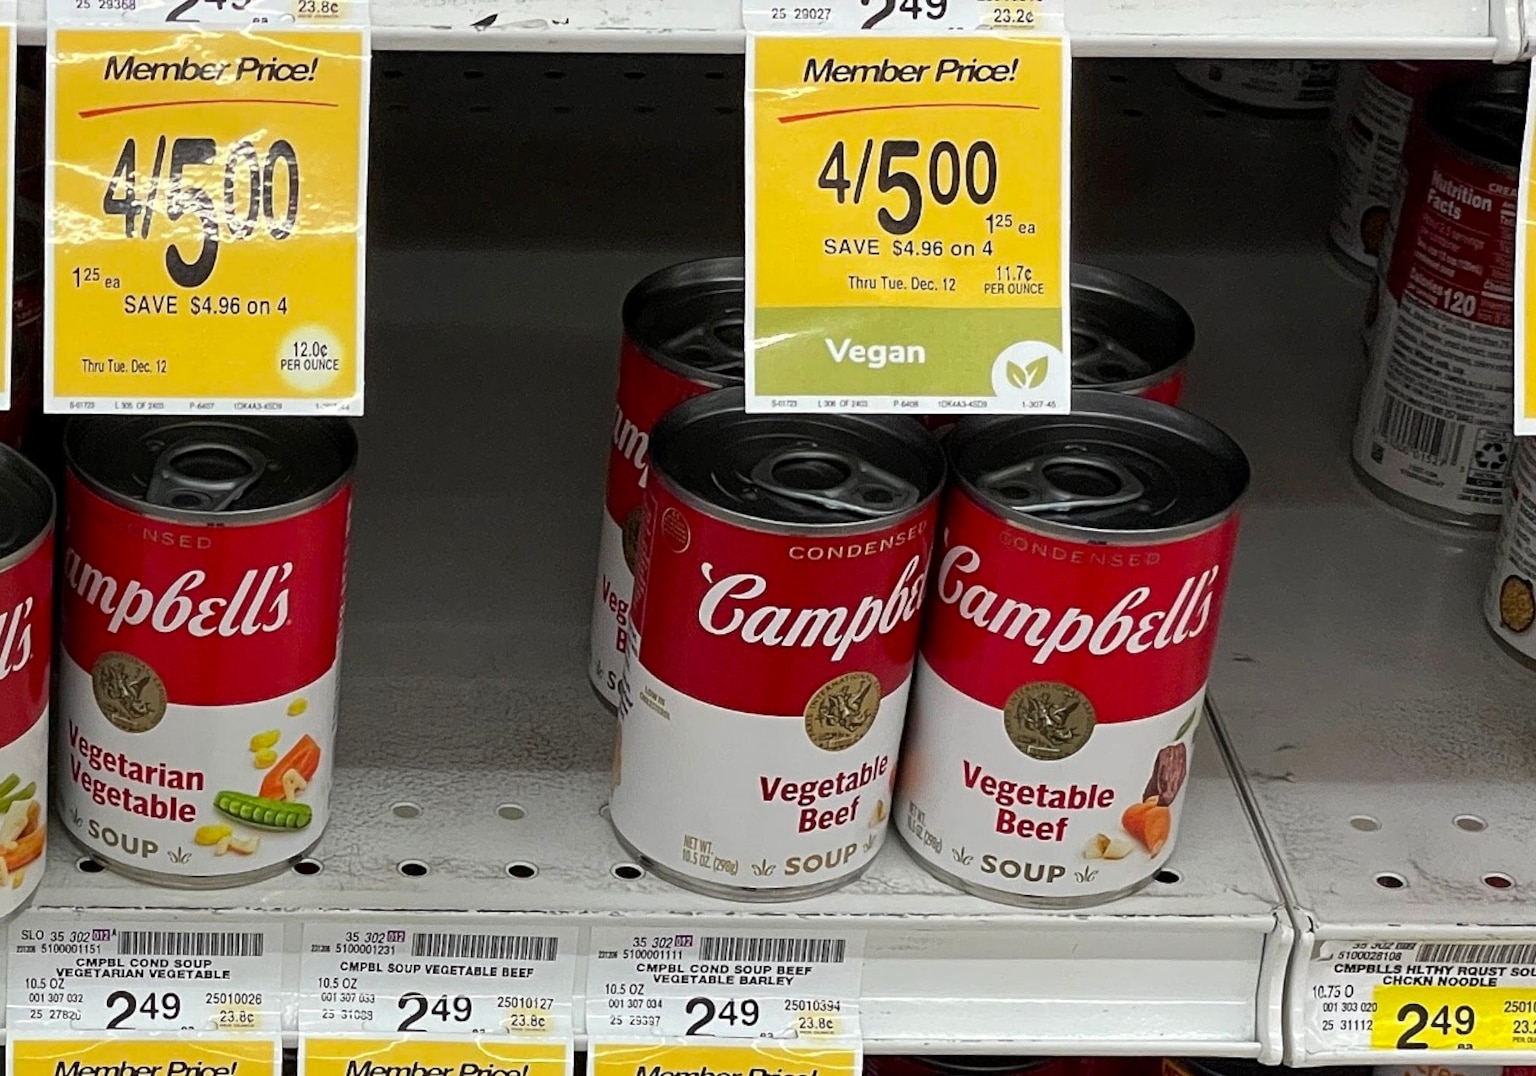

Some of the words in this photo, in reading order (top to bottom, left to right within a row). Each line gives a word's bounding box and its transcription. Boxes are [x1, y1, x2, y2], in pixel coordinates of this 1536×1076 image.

[803, 59, 930, 83] Member
[937, 60, 1018, 82] Price!
[1431, 169, 1492, 212] Nutrition
[1427, 193, 1462, 221] Facts
[824, 239, 880, 256] SAVE
[893, 238, 943, 257] $4.96
[950, 243, 975, 256] on
[983, 239, 993, 256] 4
[1443, 288, 1476, 318] 120
[281, 359, 300, 370] PER
[305, 359, 338, 370] OUNCE
[826, 338, 926, 373] Vegan
[937, 528, 1219, 664] Campbell's
[68, 718, 204, 792] Vegetarian
[69, 757, 197, 824] Vegetable
[760, 755, 888, 805] Vegetable
[963, 760, 1114, 810] Vegetable
[799, 800, 859, 833] Beef
[996, 808, 1069, 842] Beef
[88, 819, 158, 859] SOUP
[785, 844, 858, 877] SOUP
[981, 855, 1065, 882] SOUP
[56, 969, 144, 979] VEGETARIAN
[149, 969, 230, 979] VEGETABLE
[76, 959, 124, 967] CMPBL
[129, 959, 168, 968] COND
[174, 959, 212, 968] SOUP
[340, 962, 382, 973] CMPBL
[386, 963, 421, 974] SOUP
[425, 966, 497, 977] VEGETABLE
[501, 967, 534, 978] BEEF
[637, 963, 684, 974] CMPBL
[690, 964, 729, 975] COND
[734, 965, 772, 976] SOUP
[777, 966, 813, 977] BEEF
[1334, 964, 1402, 974] CMPBLLS
[1406, 965, 1454, 974] HLTHY
[1458, 966, 1507, 976] RQUST
[653, 974, 734, 985] VEGETABLE
[739, 975, 794, 986] BARLEY
[1383, 976, 1433, 985] CHCKN
[1438, 977, 1497, 986] NOODLE
